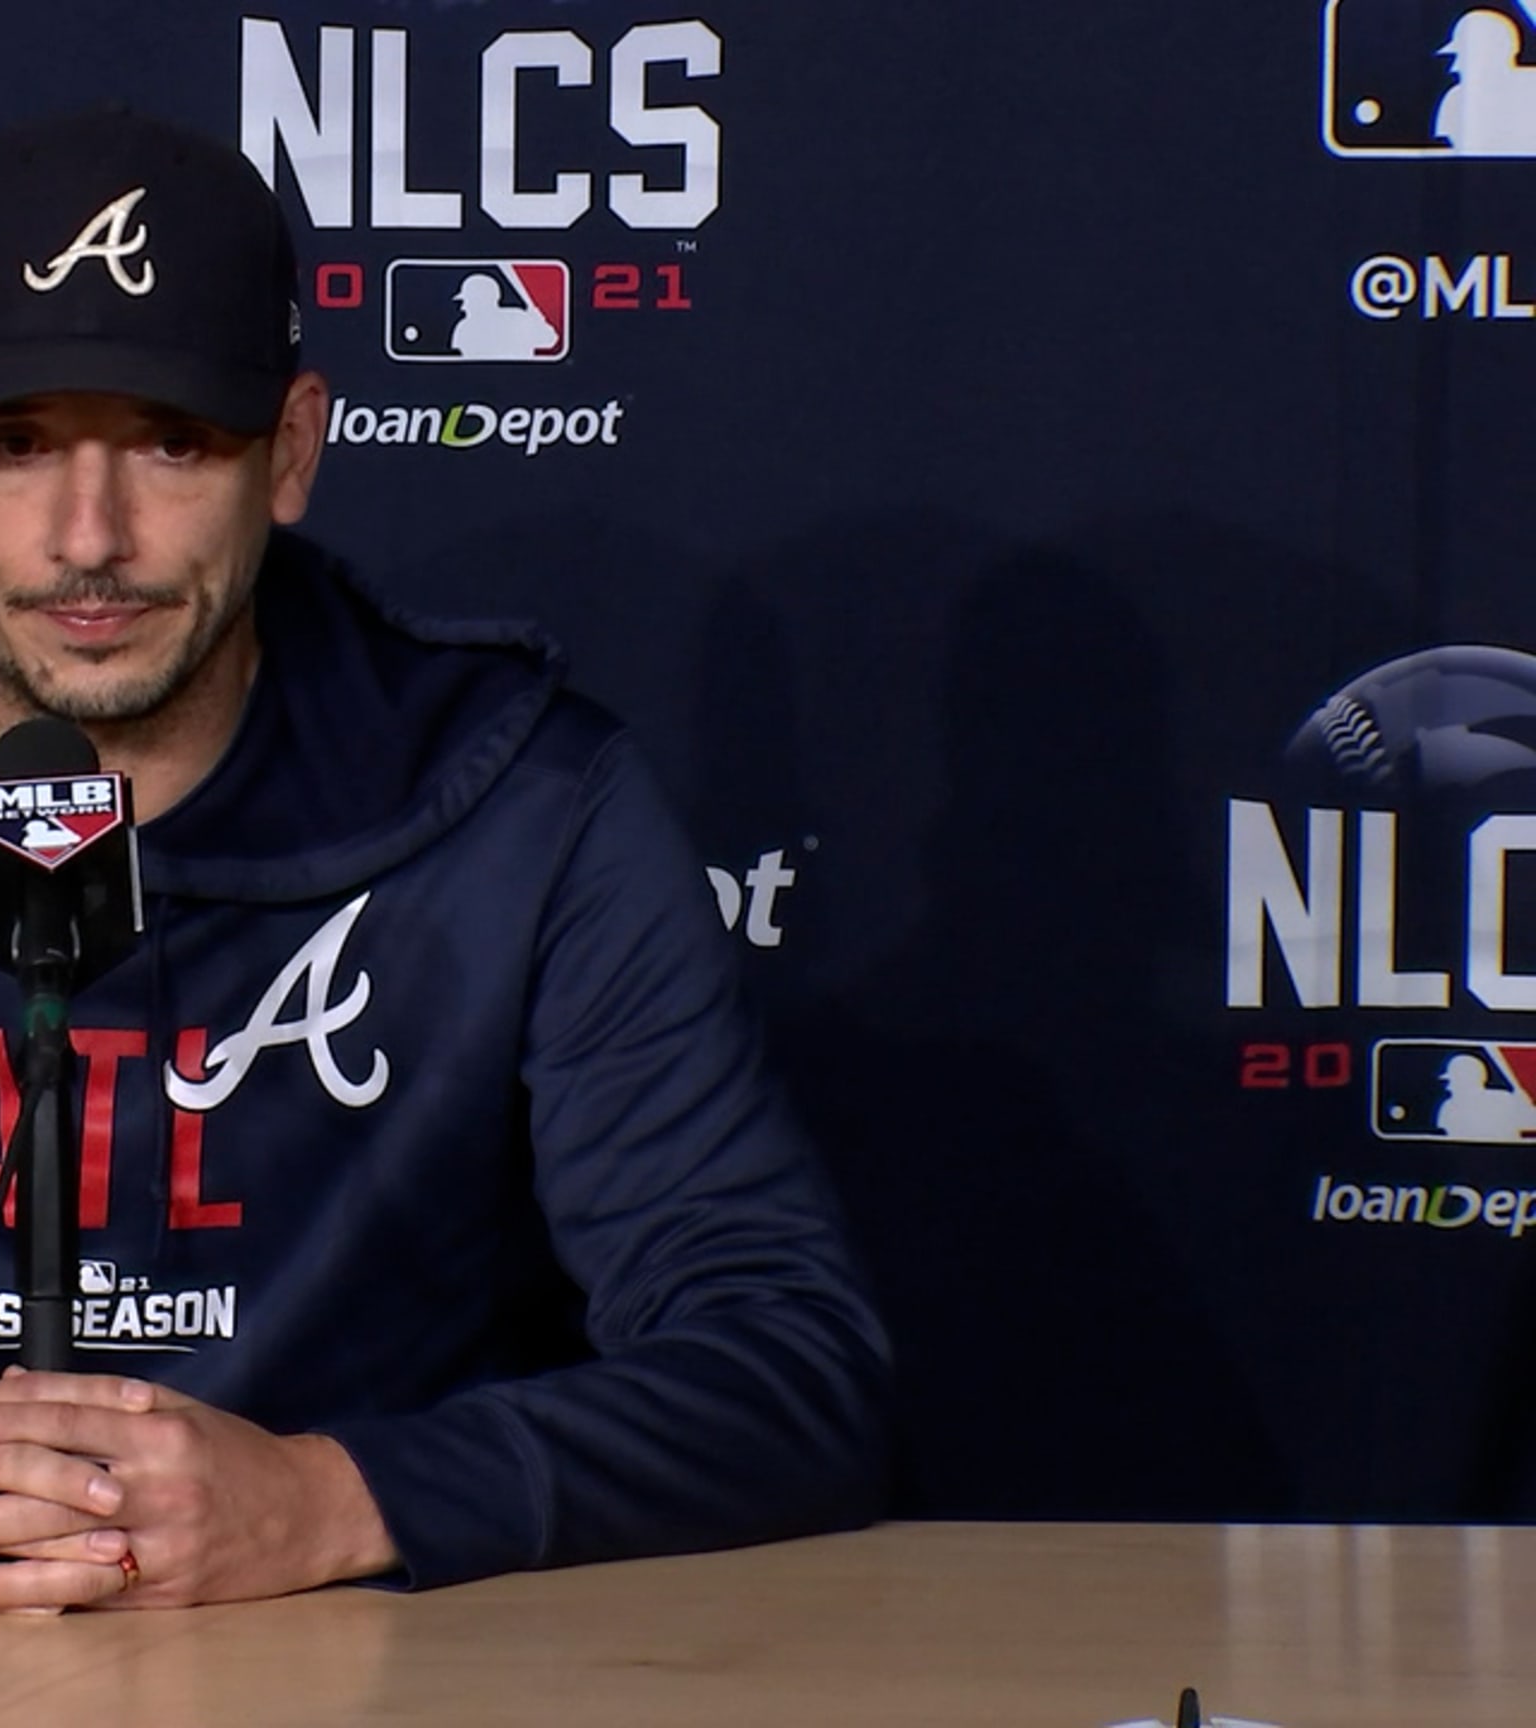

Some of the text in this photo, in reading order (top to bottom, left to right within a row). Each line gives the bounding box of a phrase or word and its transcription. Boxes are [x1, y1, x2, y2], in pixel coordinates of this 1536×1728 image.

[240, 17, 721, 229] NLCS
[593, 264, 692, 309] 21
[1350, 255, 1536, 319] @ML
[327, 398, 623, 454] loanDepot
[1240, 1042, 1351, 1088] 20
